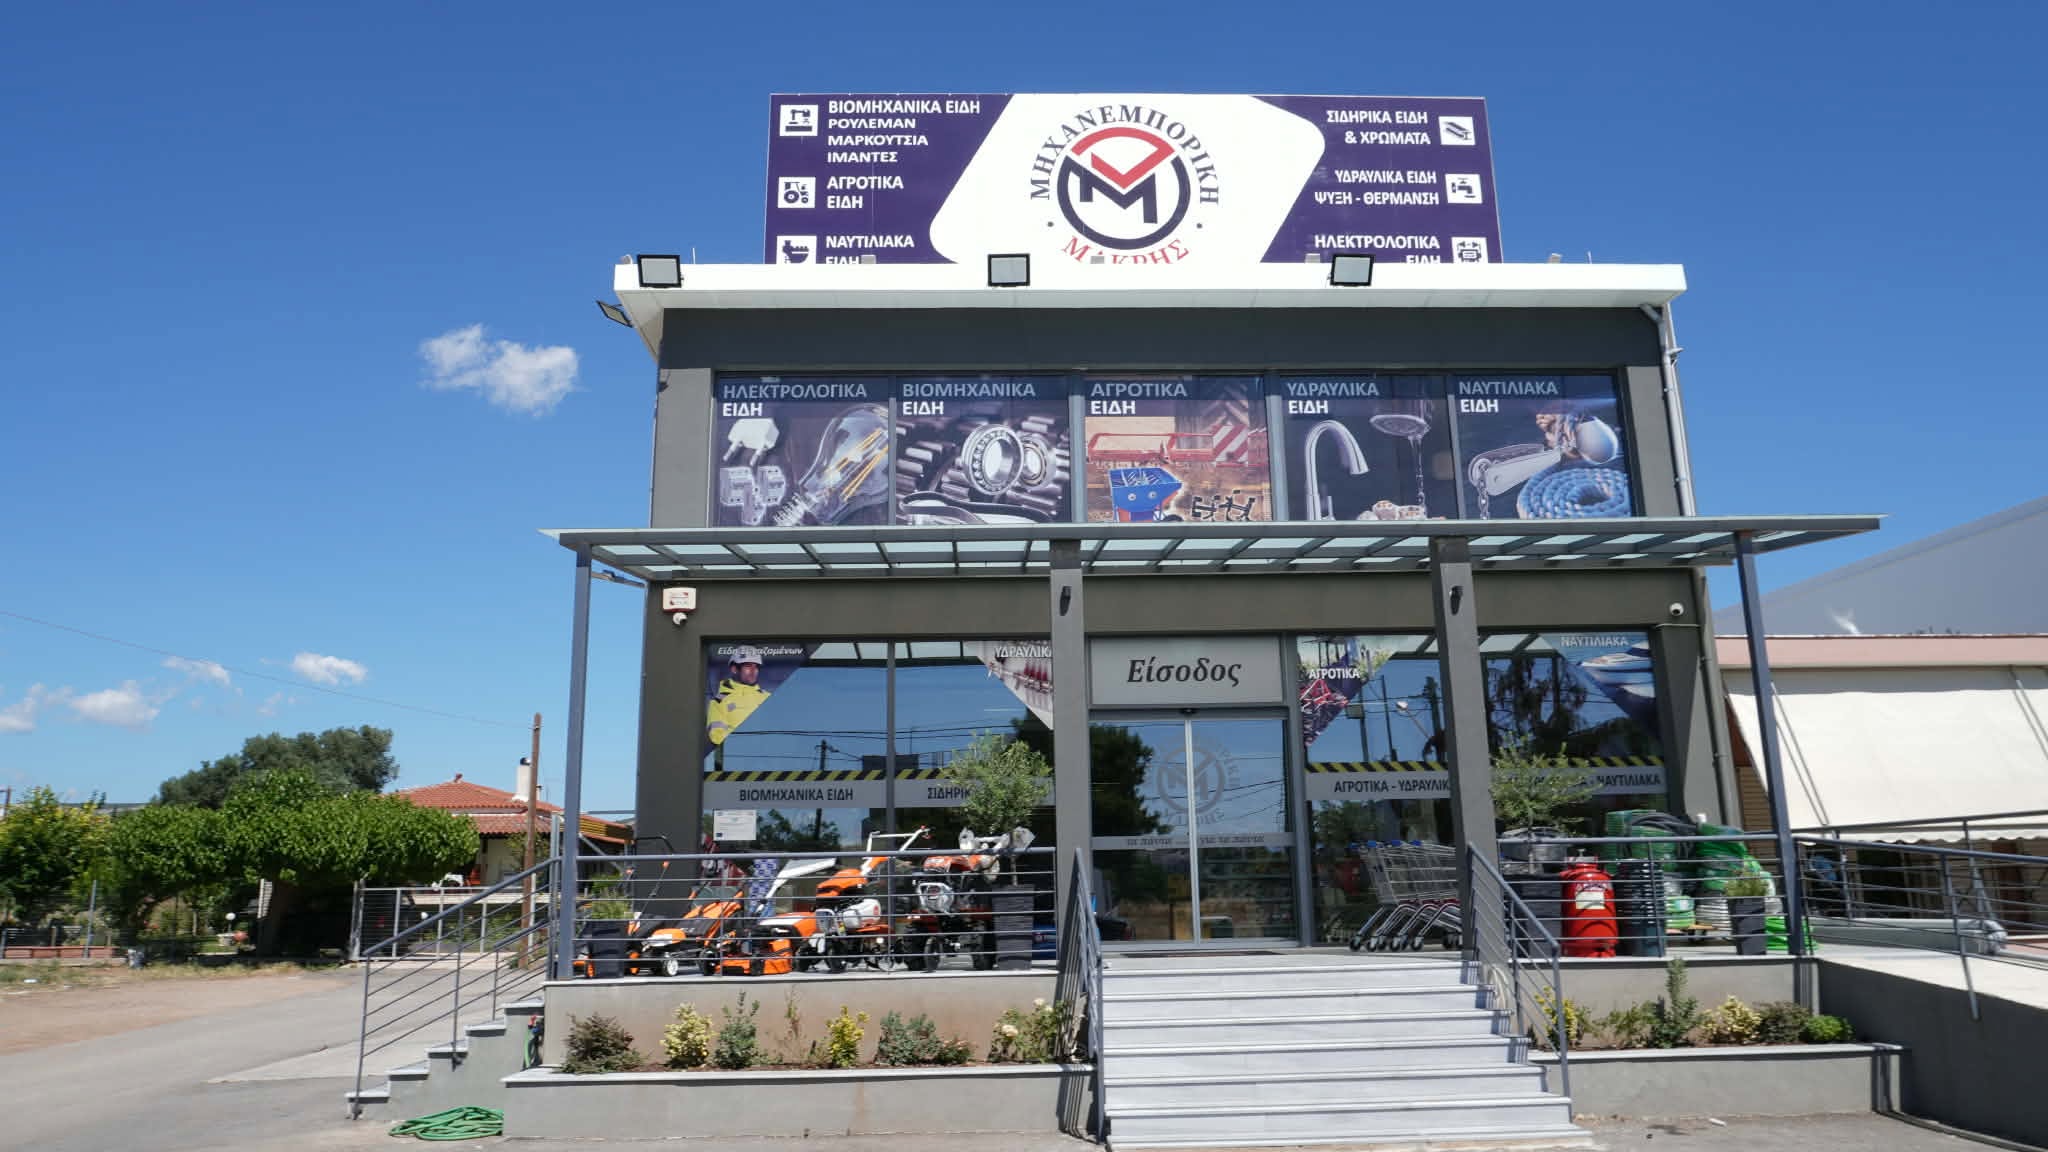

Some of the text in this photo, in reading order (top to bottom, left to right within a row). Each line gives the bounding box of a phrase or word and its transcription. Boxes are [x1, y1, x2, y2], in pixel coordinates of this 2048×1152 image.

[828, 100, 980, 114] ΒΙΟΜΗΧΑΝΙΚΑ ΕΙΔΗ
[828, 118, 916, 129] ΡΟΥΛΕΜΑΝ
[1326, 110, 1428, 124] ΣΙΔΗΡΙΚΑ ΕΙΔΗ
[827, 135, 929, 146] ΜΑΡΚΟΥΤΣΙΑ
[1345, 131, 1431, 145] & ΧΡΩΜΑΤΑ
[827, 151, 898, 163] ΙΜΑΝΤΕΣ
[1030, 103, 1219, 205] ΜΗΧΑΝΕΜΠΟΡΙΚΗ
[827, 176, 904, 190] ΑΓΡΟΤΙΚΑ
[1335, 170, 1437, 184] ΥΔΡΑΥΛΙΚΑ ΕΙΔΗ
[826, 196, 864, 209] ΕΙΔΗ
[1314, 192, 1353, 205] ΨΥΞΗ
[1364, 192, 1439, 205] ΘΕΡΜΑΝΣΗ
[826, 235, 915, 249] ΝΑΥΤΙΛΙΑΚΑ
[1315, 235, 1440, 249] ΗΛΕΚΤΡΟΛΟΓΙΚΑ
[1061, 235, 1190, 264] ΜΚΡΗΣ
[723, 384, 867, 399] ΗΛΕΚΤΡΟΛΟΓΙΚΑ
[903, 383, 1036, 397] ΒΙΟΜΗΧΑΝΙΚΑ
[1091, 383, 1187, 397] ΑΓΡΟΤΙΚΑ
[1287, 382, 1379, 397] ΥΔΡΑΥΛΙΚΑ
[1459, 381, 1558, 396] ΝΑΥΤΙΛΙΑΚΑ
[722, 403, 763, 417] ΕΙΔΗ
[903, 401, 944, 415] ΕΙΔΗ
[1091, 400, 1136, 415] ΕΙΔΗ
[1288, 401, 1329, 415] ΕΙΔΗ
[1460, 398, 1499, 413] ΕΙΔΗ
[1560, 635, 1629, 647] ΝΑΥΤΙΛΙΑΚΑ
[1127, 656, 1242, 687] Είσοδος
[1309, 667, 1361, 680] ΑΓΡΟΤΙΚΑ
[928, 787, 971, 799] ΣΙΔΗΡΙΚ
[1334, 780, 1388, 793] ΑΓΡΟΤΙΚΑ
[1399, 779, 1450, 792] ΥΔΡΑΥΛΙΚ
[739, 788, 854, 801] ΒΙΟΜΗΧΑΝΙΚΑ ΕΙΔΗ
